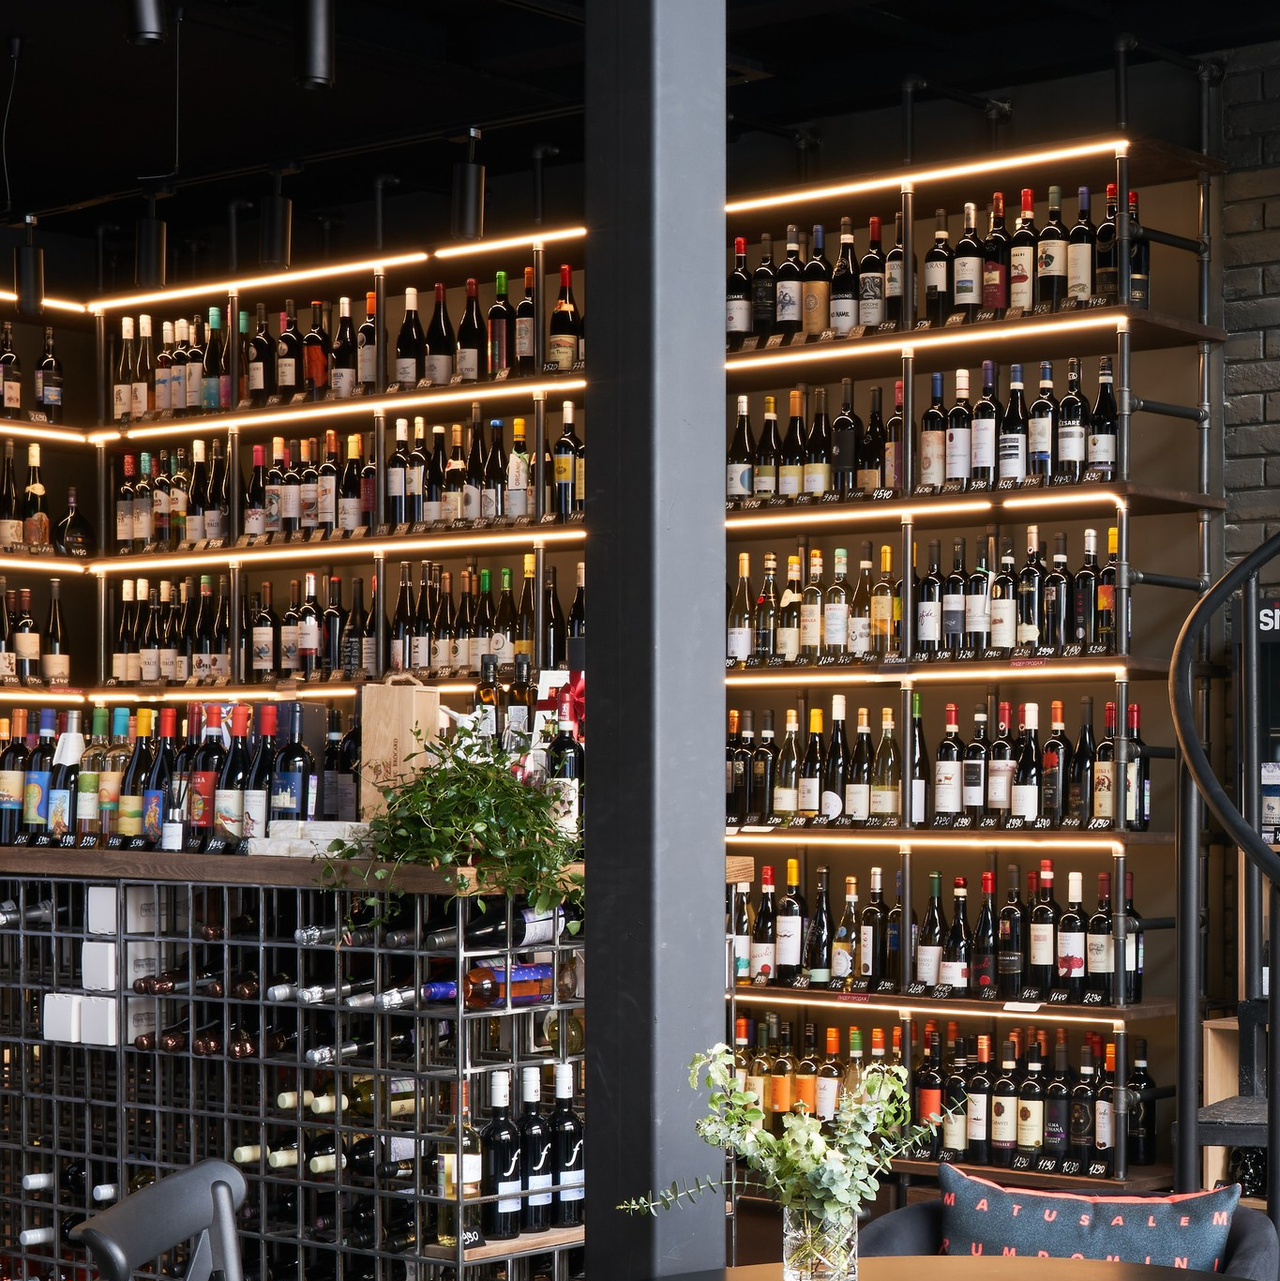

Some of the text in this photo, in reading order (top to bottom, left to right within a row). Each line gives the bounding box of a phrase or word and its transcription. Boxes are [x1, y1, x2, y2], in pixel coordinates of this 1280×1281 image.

[503, 1148, 521, 1177] f
[532, 1142, 552, 1171] f
[565, 1139, 584, 1167] f
[943, 1192, 1229, 1227] MATUSALEM
[938, 1238, 1017, 1257] RUM
